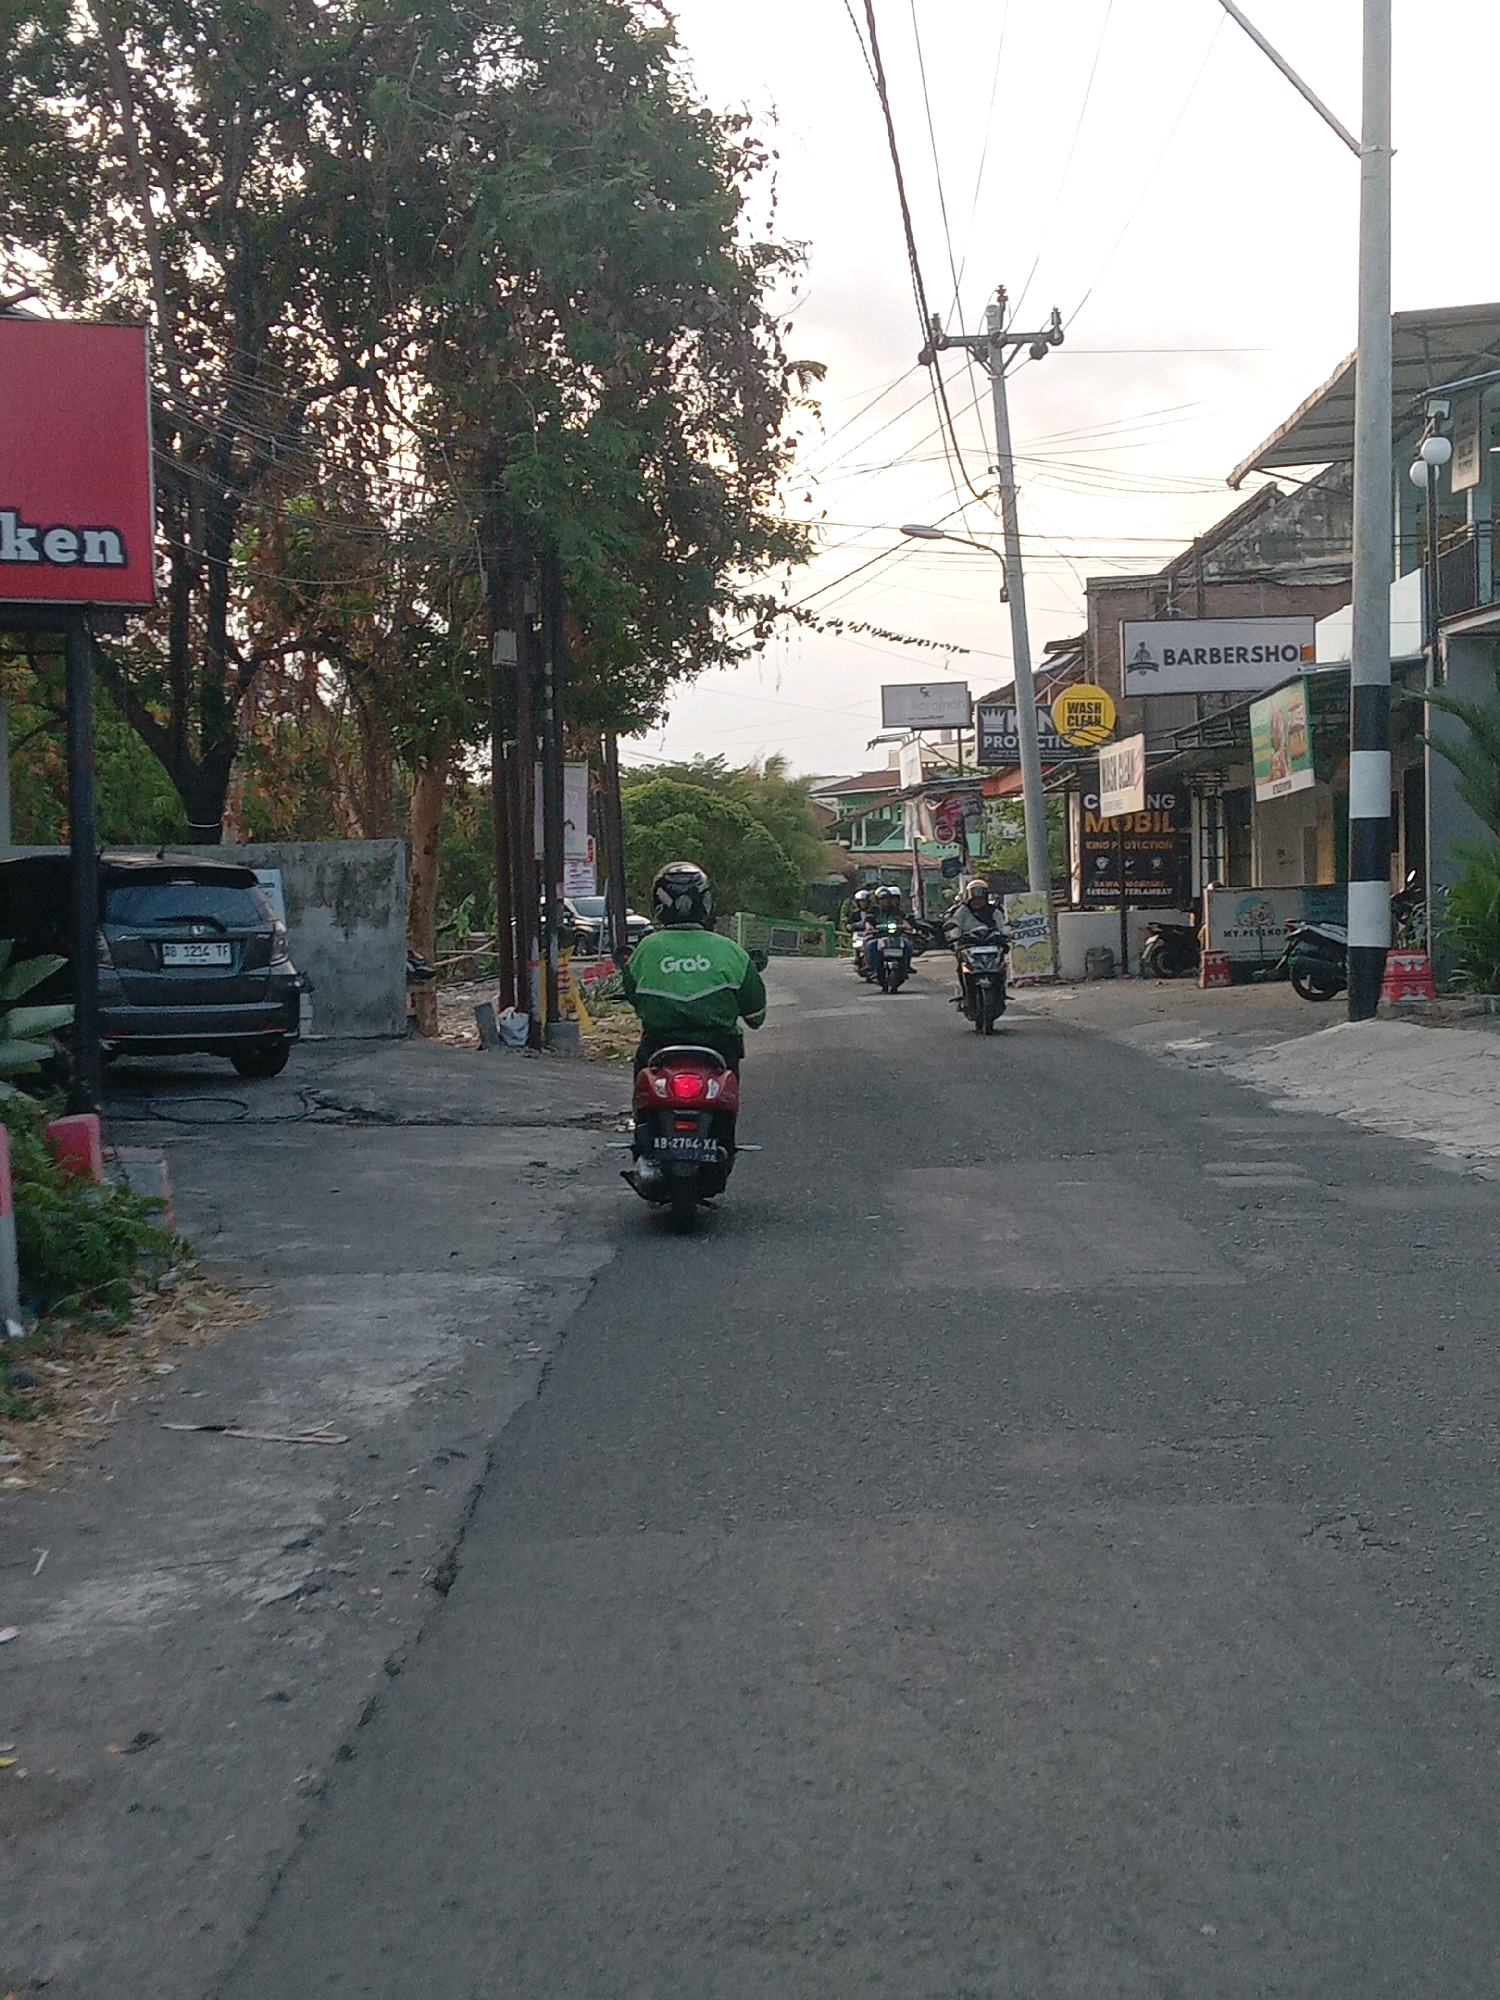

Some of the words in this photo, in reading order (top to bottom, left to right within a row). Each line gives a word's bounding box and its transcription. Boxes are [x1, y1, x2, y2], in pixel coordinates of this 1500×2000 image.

[1163, 645, 1304, 666] BARBERSHO
[1067, 702, 1102, 714] WASH
[1067, 715, 1102, 728] CLEAN
[1084, 811, 1175, 833] MOBIL
[660, 955, 711, 974] Grab
